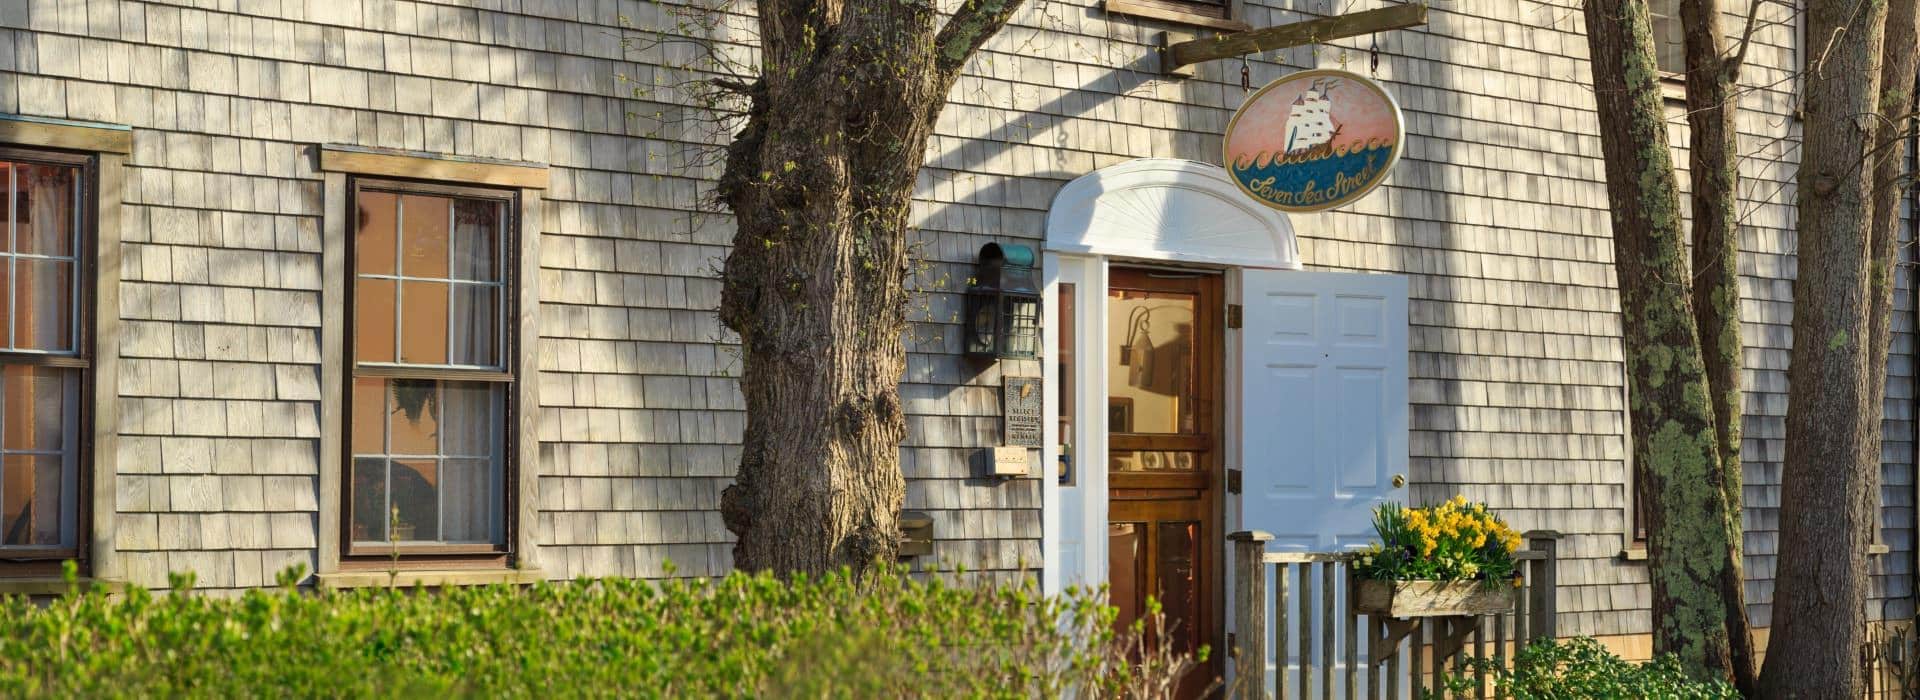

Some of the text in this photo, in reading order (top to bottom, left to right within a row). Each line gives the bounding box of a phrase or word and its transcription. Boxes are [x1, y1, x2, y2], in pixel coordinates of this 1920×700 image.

[1250, 154, 1375, 204] Seven Sea Street
